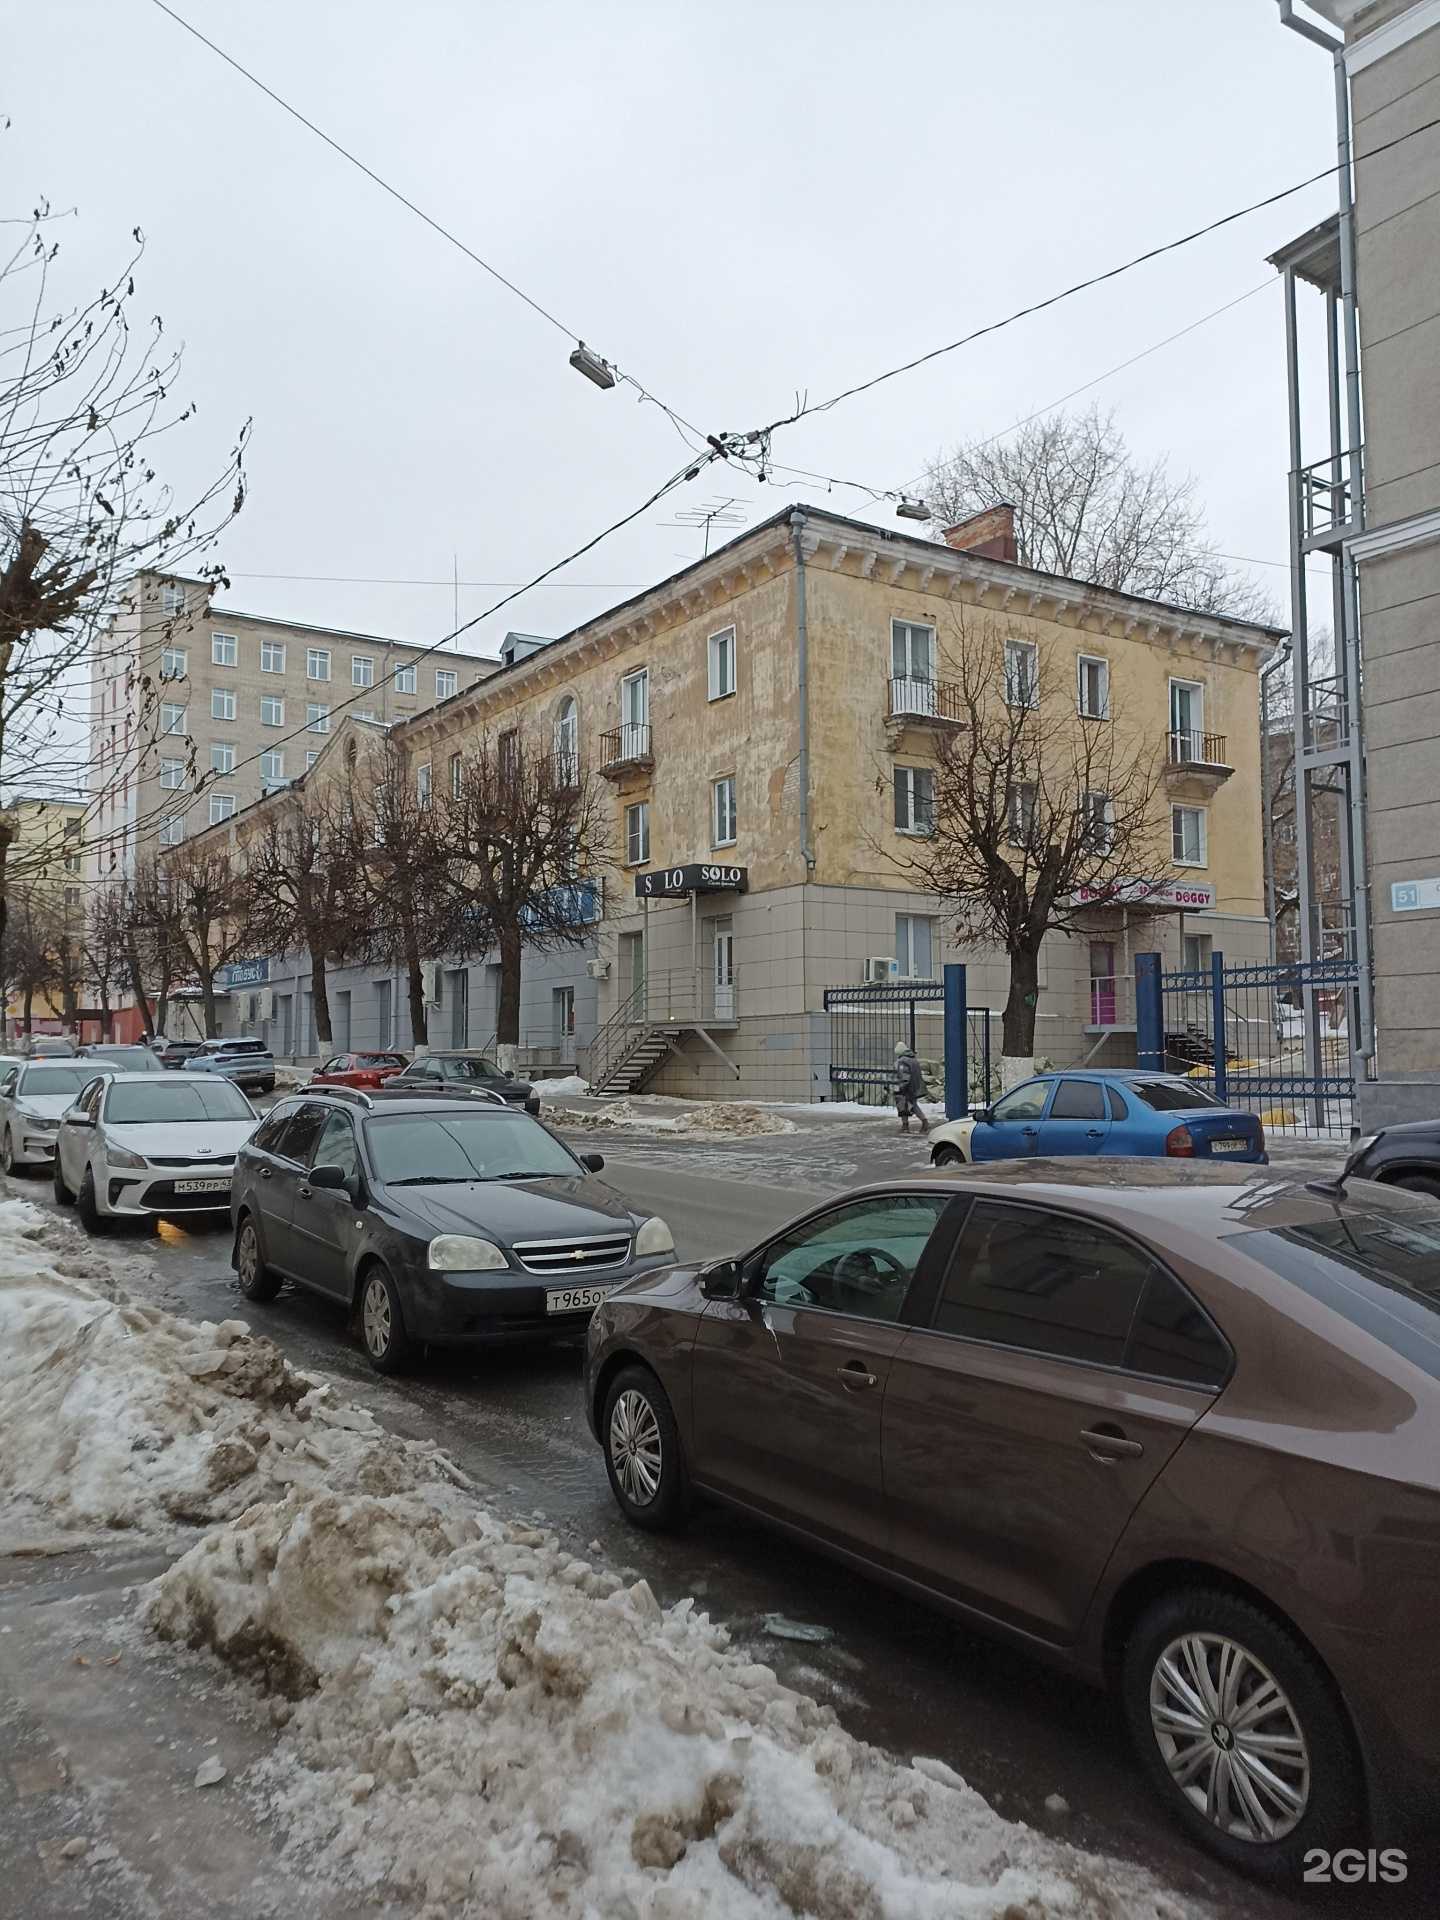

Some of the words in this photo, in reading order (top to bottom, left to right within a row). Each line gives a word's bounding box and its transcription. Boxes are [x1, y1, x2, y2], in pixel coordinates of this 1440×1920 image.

[701, 866, 741, 881] SOLO
[1176, 891, 1210, 904] DOGGY
[1399, 890, 1416, 903] 51
[553, 1289, 606, 1308] Т965О
